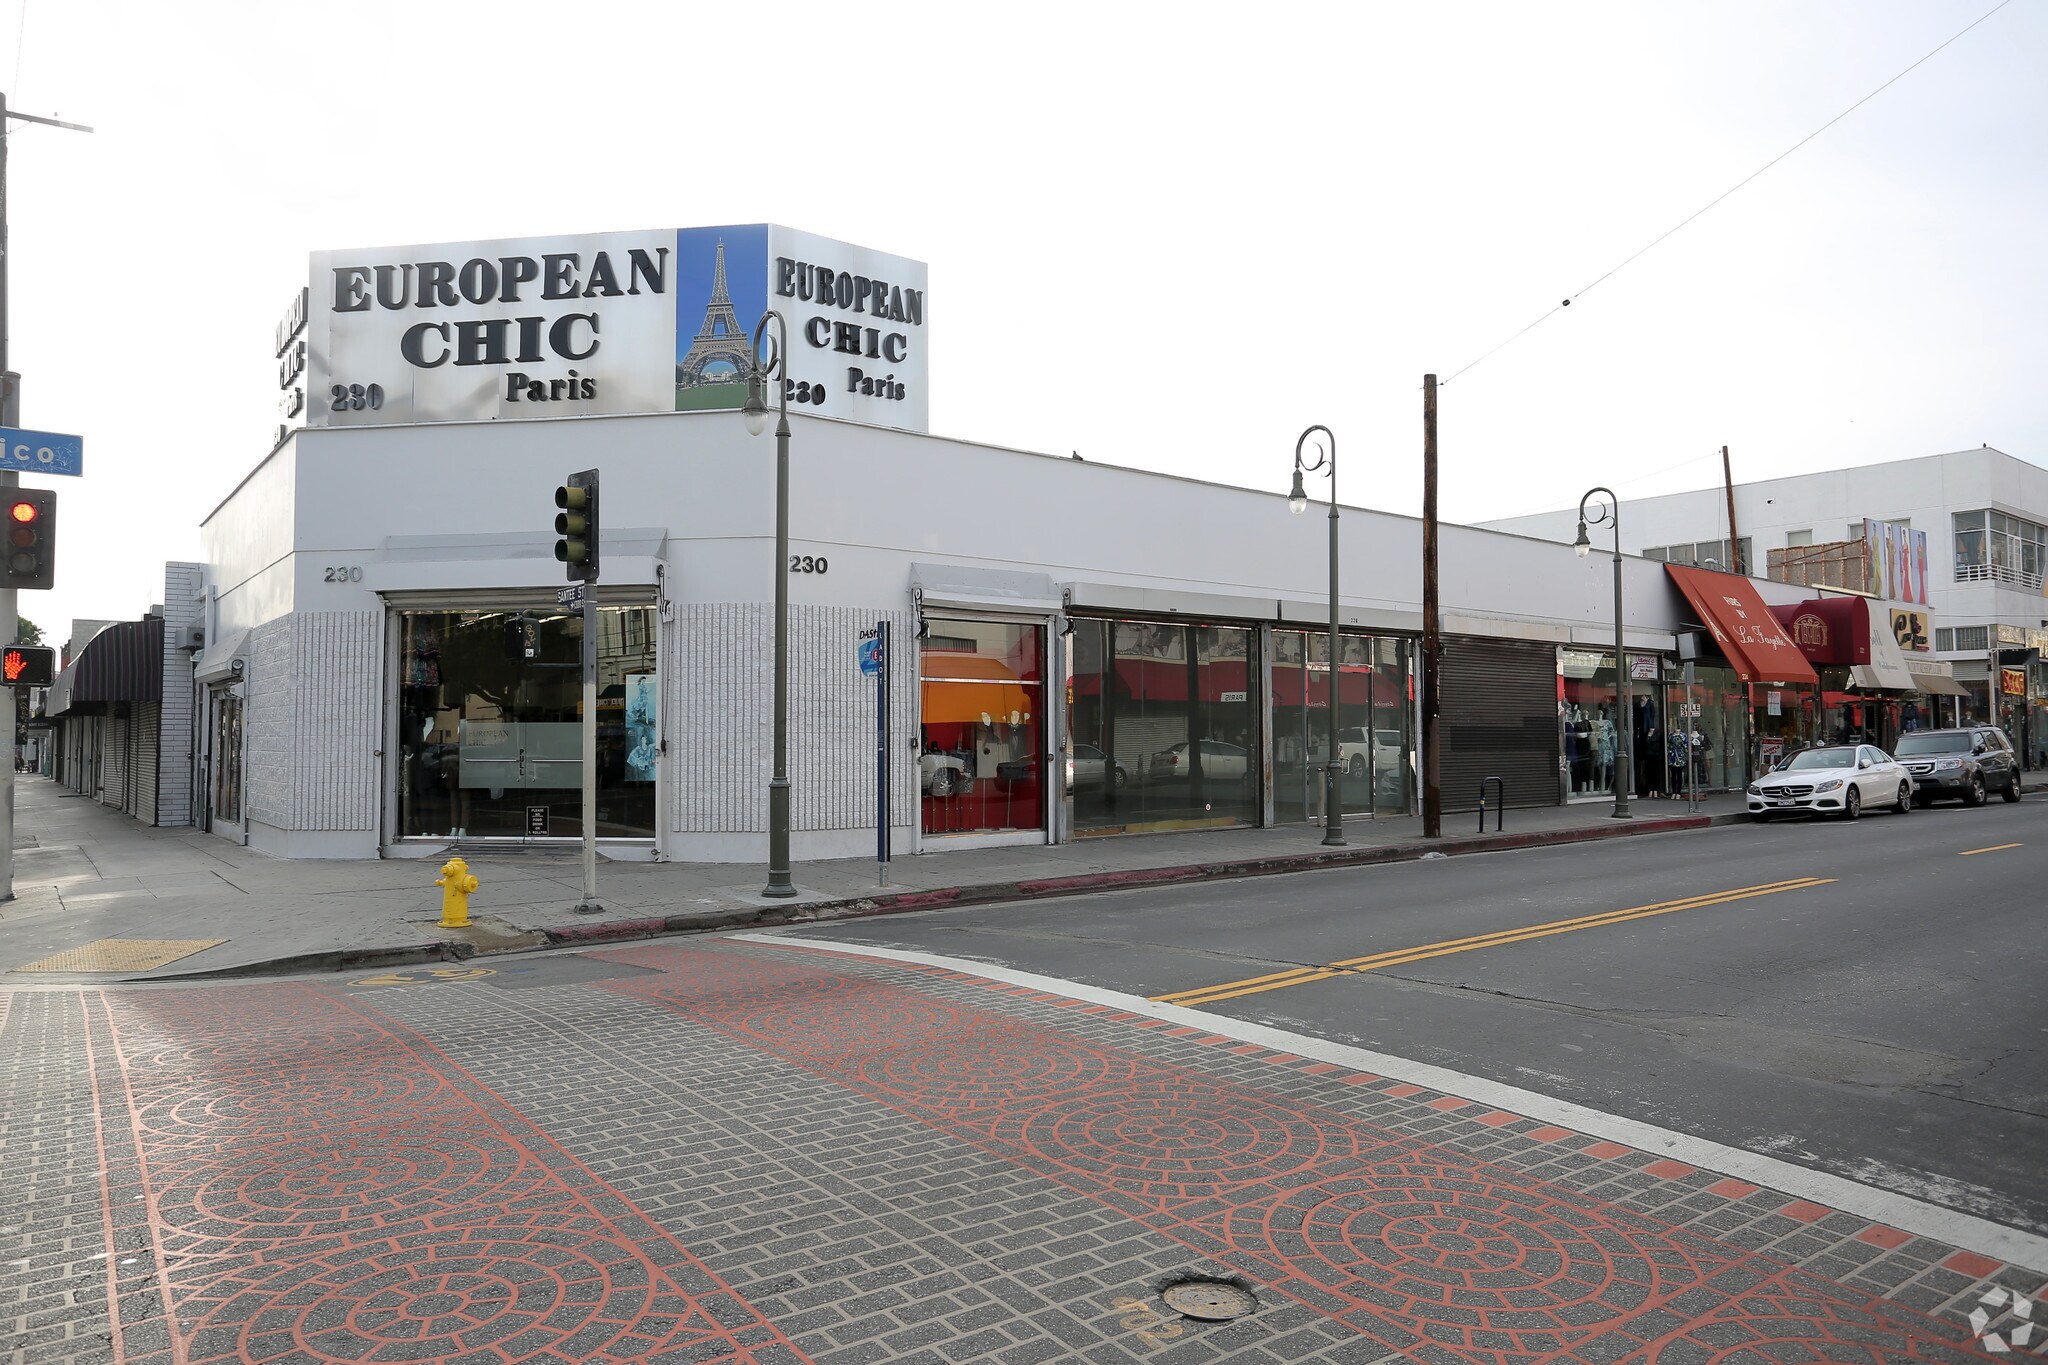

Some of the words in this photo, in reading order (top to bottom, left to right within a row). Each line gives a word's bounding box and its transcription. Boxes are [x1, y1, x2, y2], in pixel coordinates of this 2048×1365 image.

[332, 247, 669, 312] EUROPEAN
[776, 256, 923, 326] EUROPEAN
[401, 312, 600, 368] CHIC
[805, 316, 907, 363] CHIC
[331, 382, 384, 411] 230
[505, 369, 597, 402] Paris
[786, 378, 826, 405] 230
[848, 366, 906, 401] Paris
[324, 566, 363, 583] 230
[789, 555, 828, 574] 230
[557, 588, 576, 603] SANTEE
[1733, 625, 1755, 644] La
[469, 729, 509, 737] EUROPEAN
